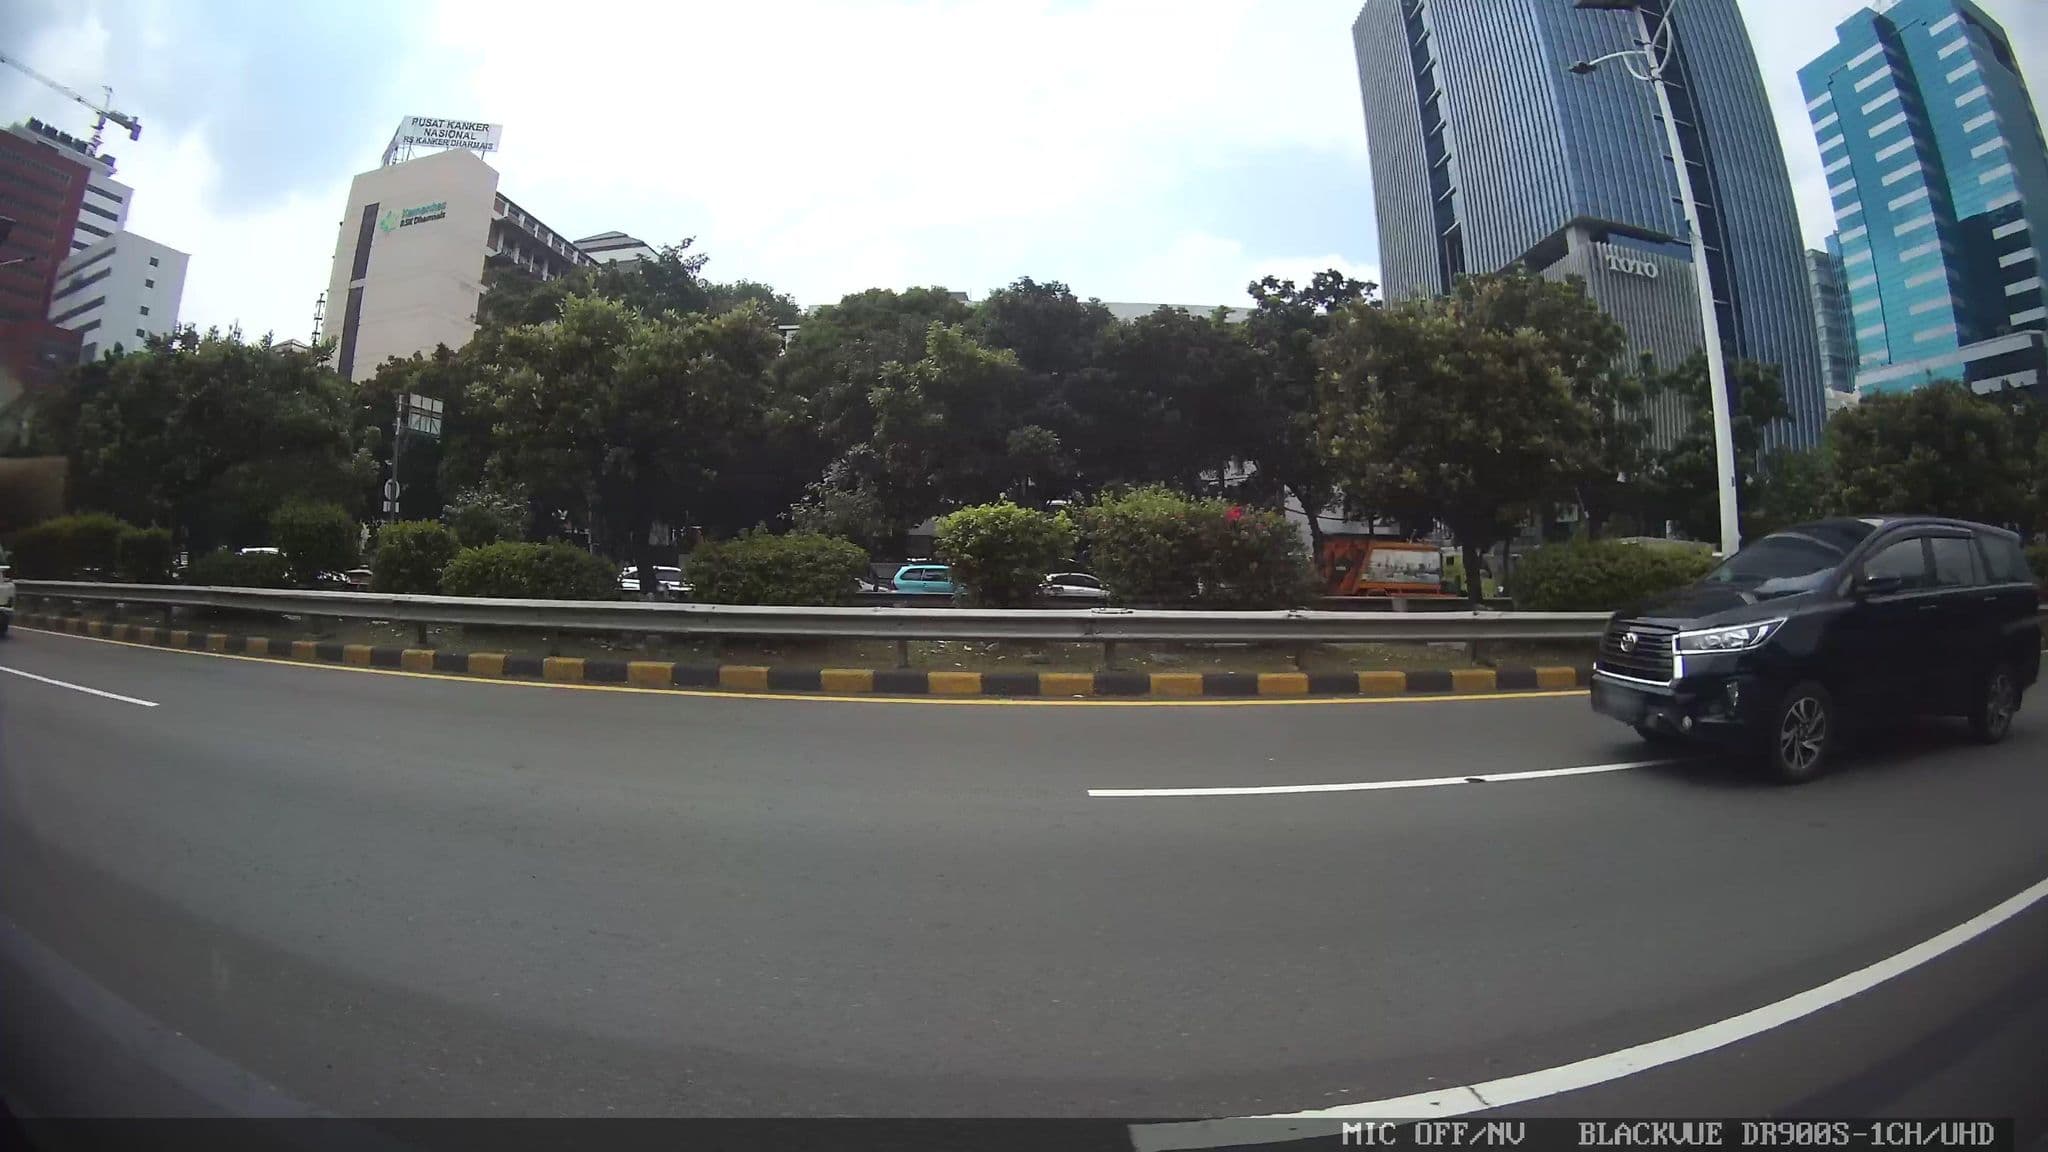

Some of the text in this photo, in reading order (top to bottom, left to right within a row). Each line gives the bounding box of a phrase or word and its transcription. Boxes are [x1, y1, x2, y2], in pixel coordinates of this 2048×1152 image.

[411, 117, 490, 132] PUSAT KANKER
[424, 127, 477, 141] NASIONAL
[403, 135, 494, 150] RS KANKER DHARMAIS
[1605, 254, 1659, 278] TOTO
